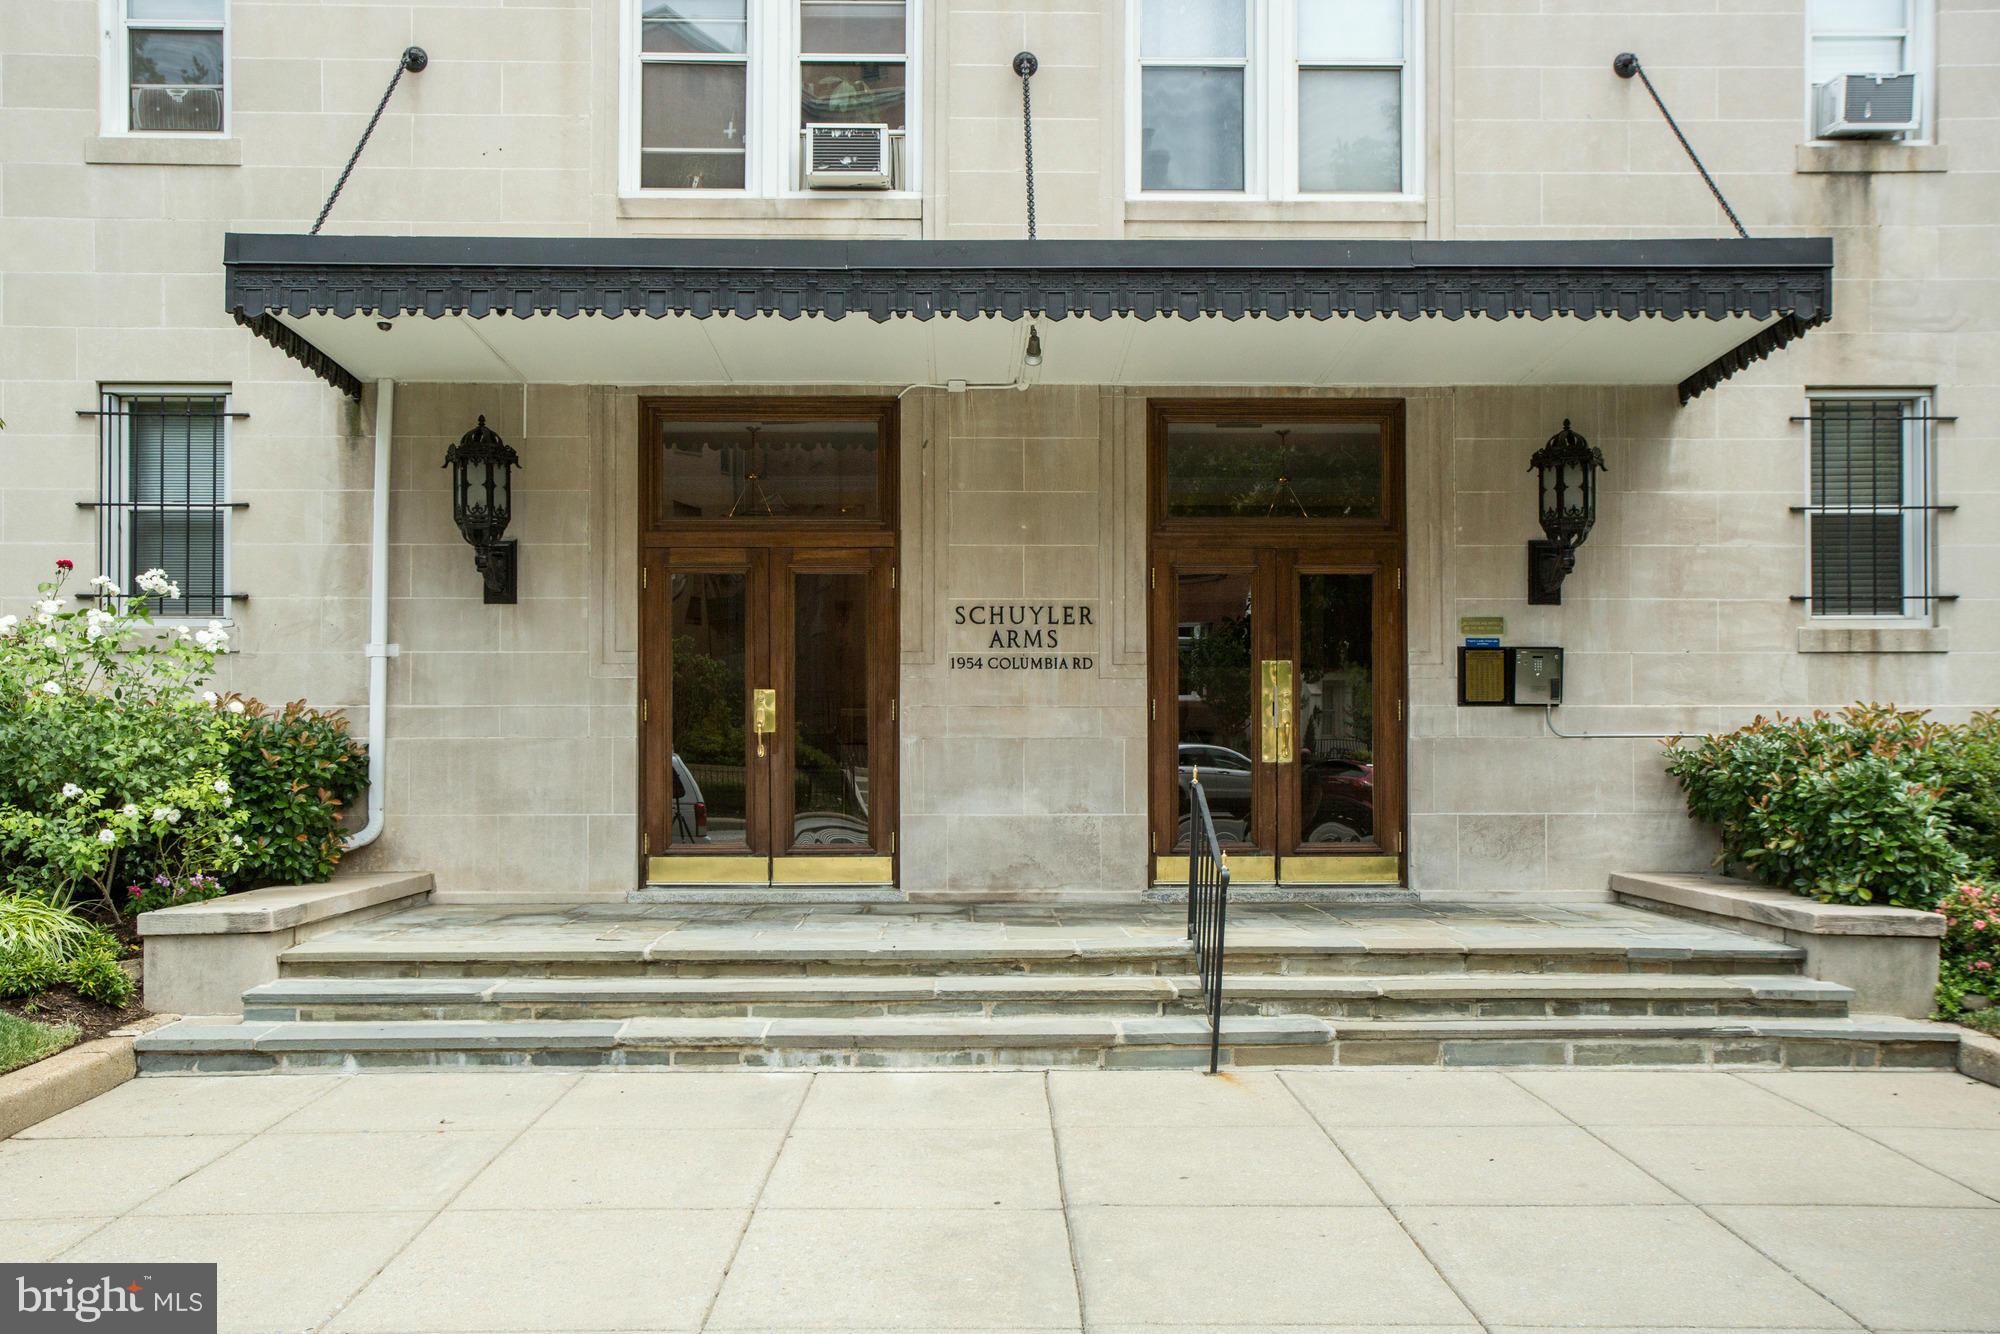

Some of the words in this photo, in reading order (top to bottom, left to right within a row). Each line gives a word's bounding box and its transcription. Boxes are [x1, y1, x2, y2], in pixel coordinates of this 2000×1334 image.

[955, 606, 1093, 625] SCHUYLER
[988, 629, 1058, 648] ARMS
[951, 657, 983, 670] 1954
[987, 656, 1068, 670] COLUMBIA
[1072, 657, 1093, 670] RD
